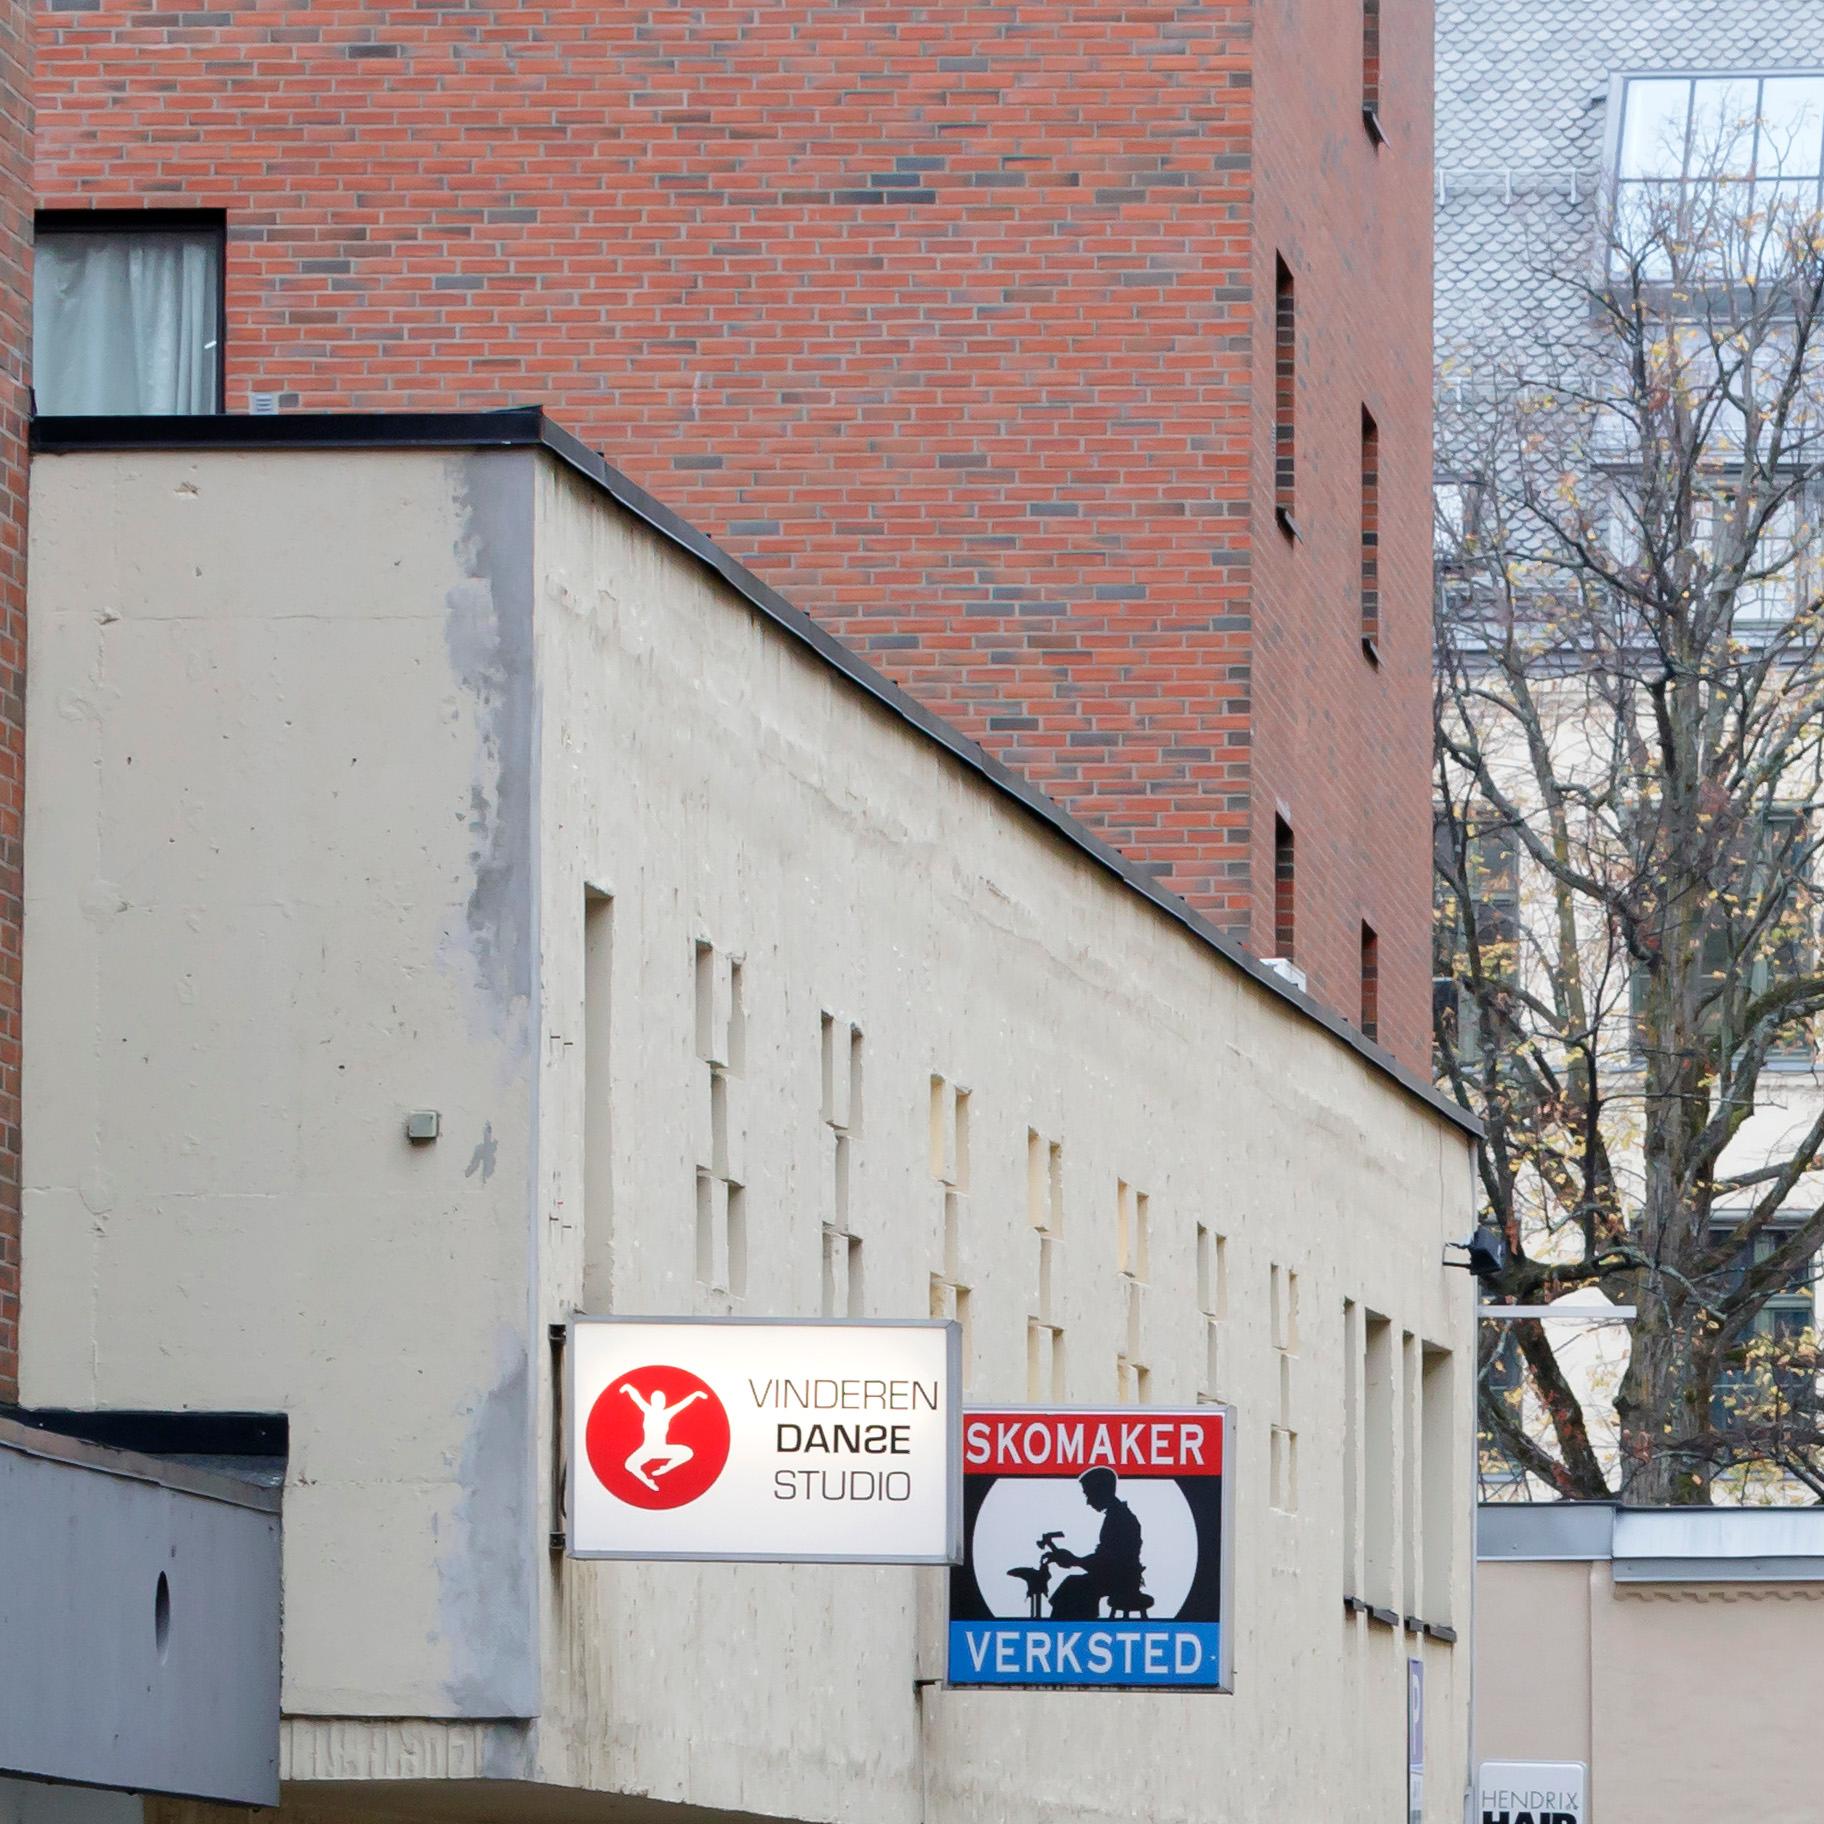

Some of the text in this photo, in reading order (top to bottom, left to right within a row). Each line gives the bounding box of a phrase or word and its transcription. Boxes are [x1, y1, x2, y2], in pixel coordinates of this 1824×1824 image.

[748, 1378, 939, 1410] VINDEREN
[966, 1422, 1206, 1466] SKOMAKER
[773, 1470, 912, 1502] STUDIO
[966, 1631, 1203, 1675] VERKSTED
[1482, 1789, 1579, 1811] HENDRIX
